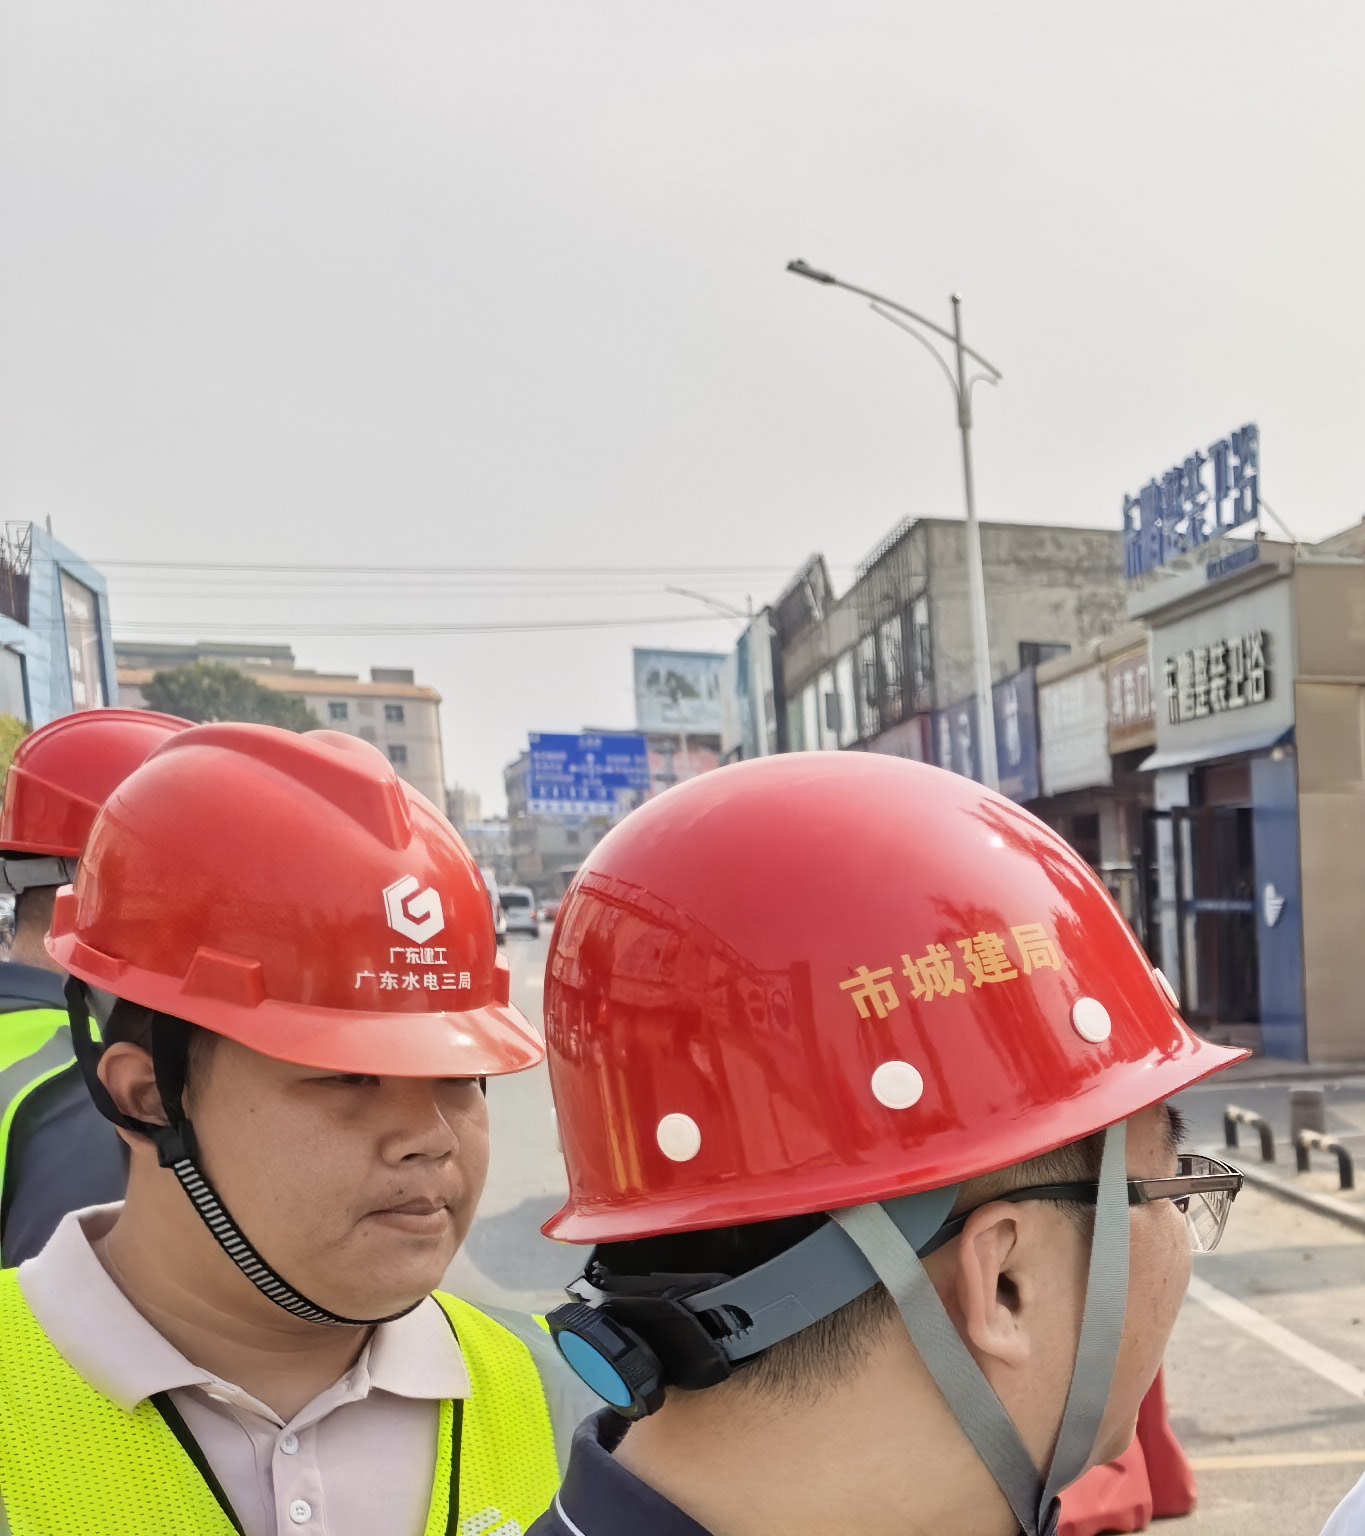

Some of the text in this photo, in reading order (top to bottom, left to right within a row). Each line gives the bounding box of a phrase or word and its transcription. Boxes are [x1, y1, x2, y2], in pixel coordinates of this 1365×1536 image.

[389, 947, 448, 965] 广东建工
[354, 970, 471, 990] 广东水电三局
[839, 922, 1063, 1019] 市城建局
